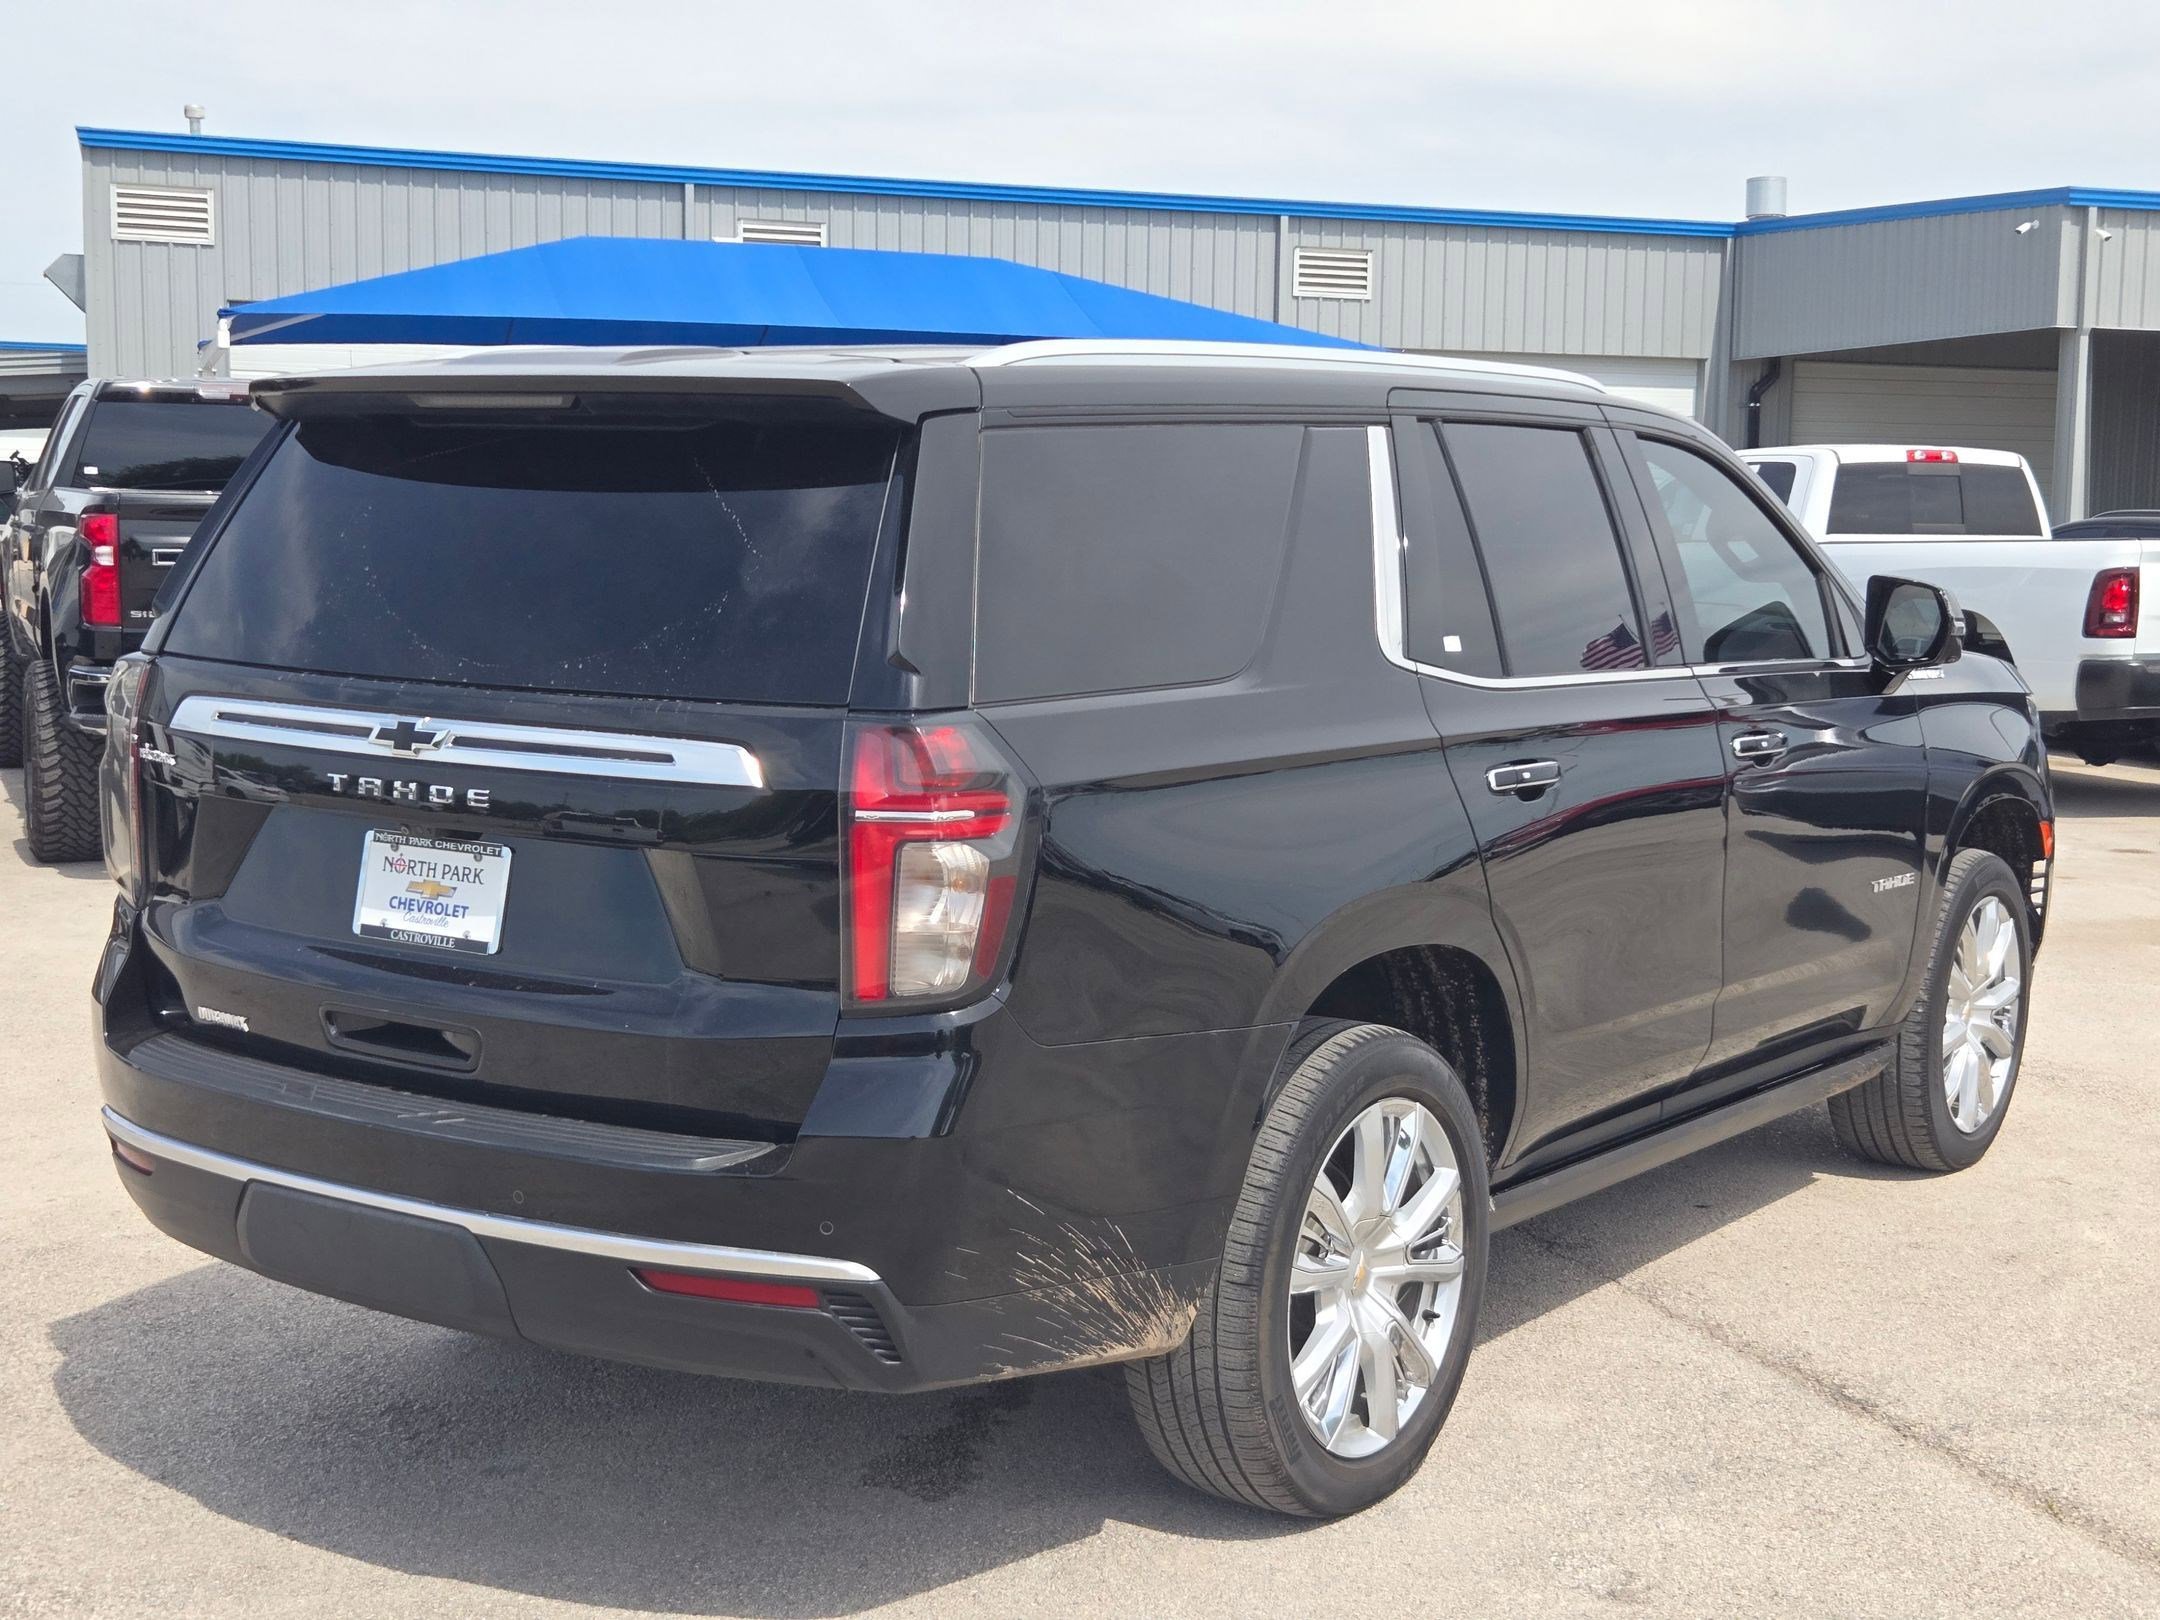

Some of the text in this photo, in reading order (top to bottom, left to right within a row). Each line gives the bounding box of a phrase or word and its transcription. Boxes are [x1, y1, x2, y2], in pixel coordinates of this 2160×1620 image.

[327, 773, 491, 808] TAHOE
[375, 832, 501, 856] NORTH PARK CHEVROLET
[382, 853, 485, 885] NORTH PARK
[1871, 872, 1915, 893] TAHOE
[389, 896, 469, 919] CHEVROLET
[403, 911, 449, 928] Castroville
[390, 930, 456, 949] CASTROVILLE
